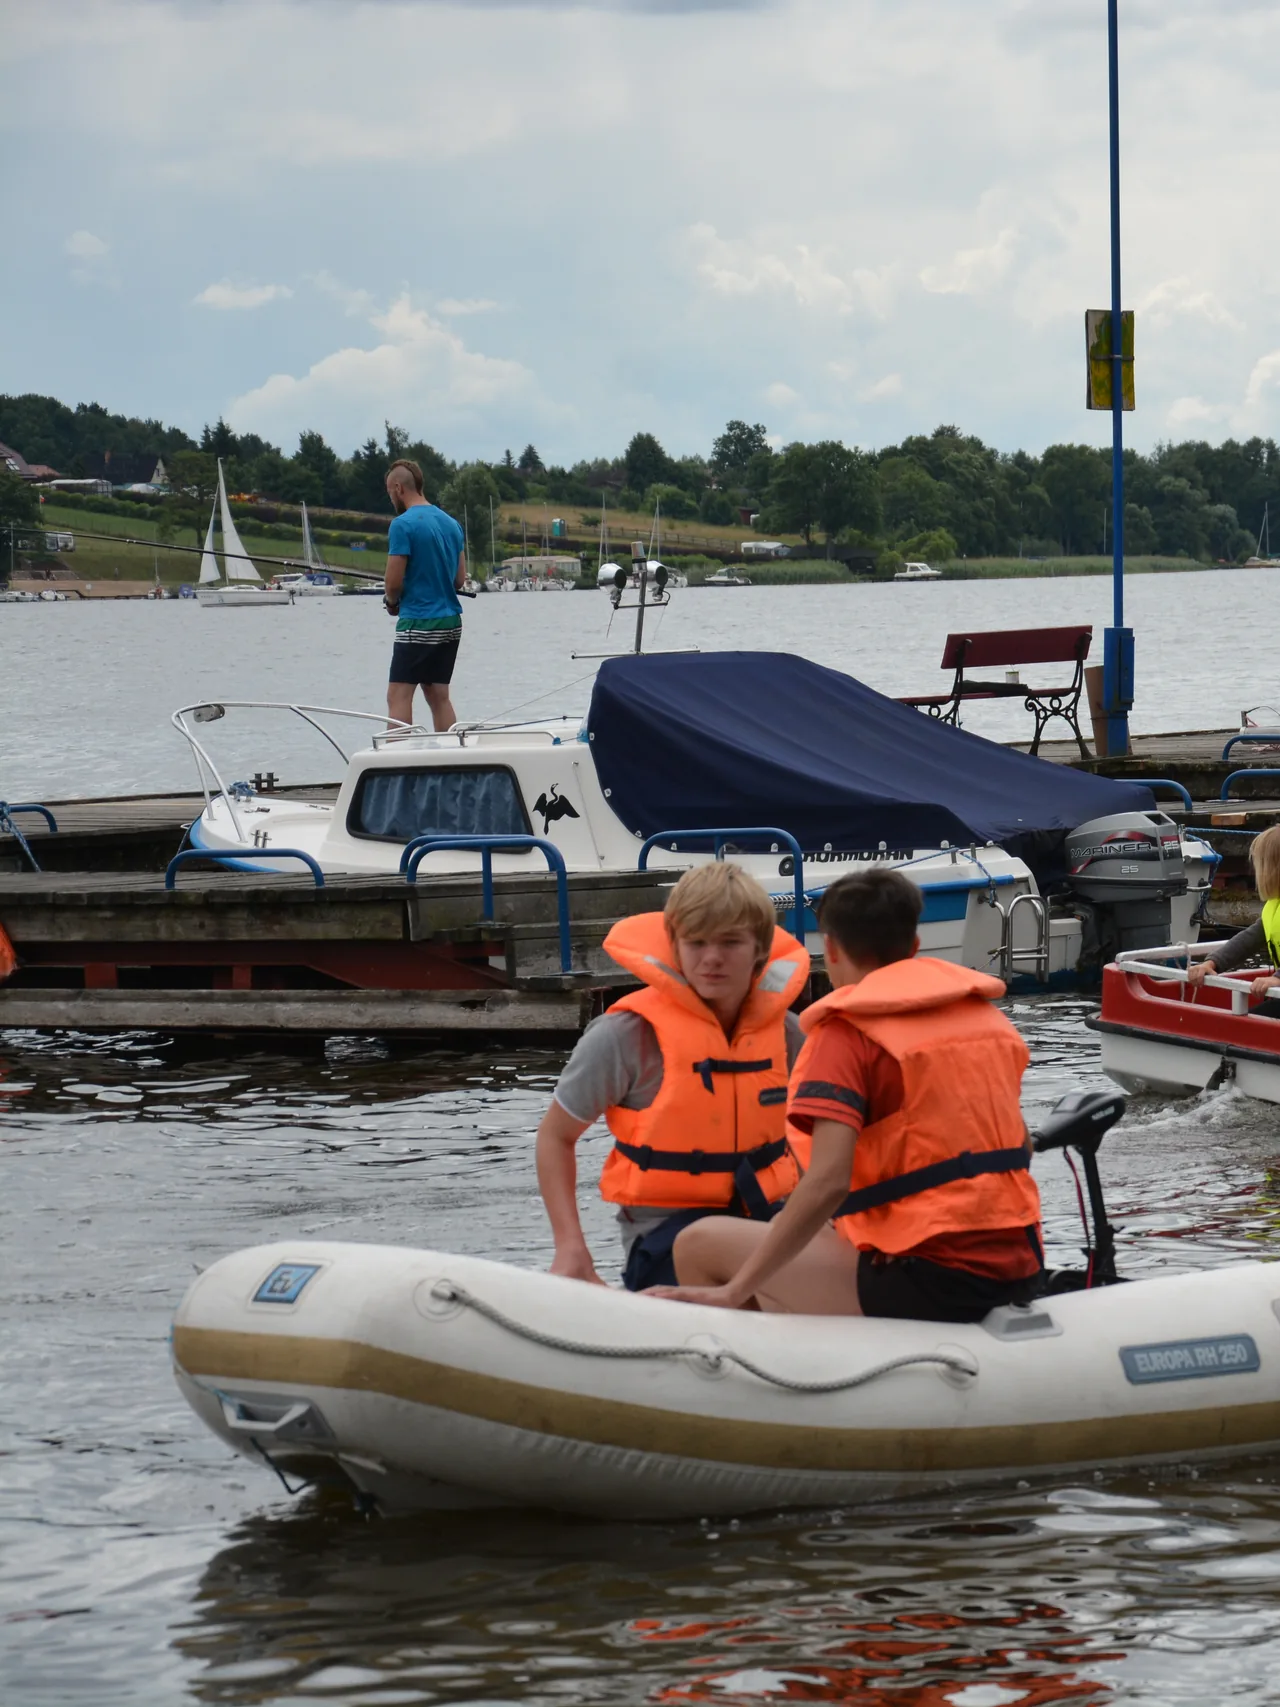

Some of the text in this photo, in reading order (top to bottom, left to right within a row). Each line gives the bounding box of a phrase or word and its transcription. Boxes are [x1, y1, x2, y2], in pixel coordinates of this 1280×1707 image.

[1070, 842, 1153, 858] MARINER
[1163, 840, 1180, 850] 25
[1121, 865, 1139, 874] 25
[1134, 1343, 1248, 1373] EUROPA RH 250
